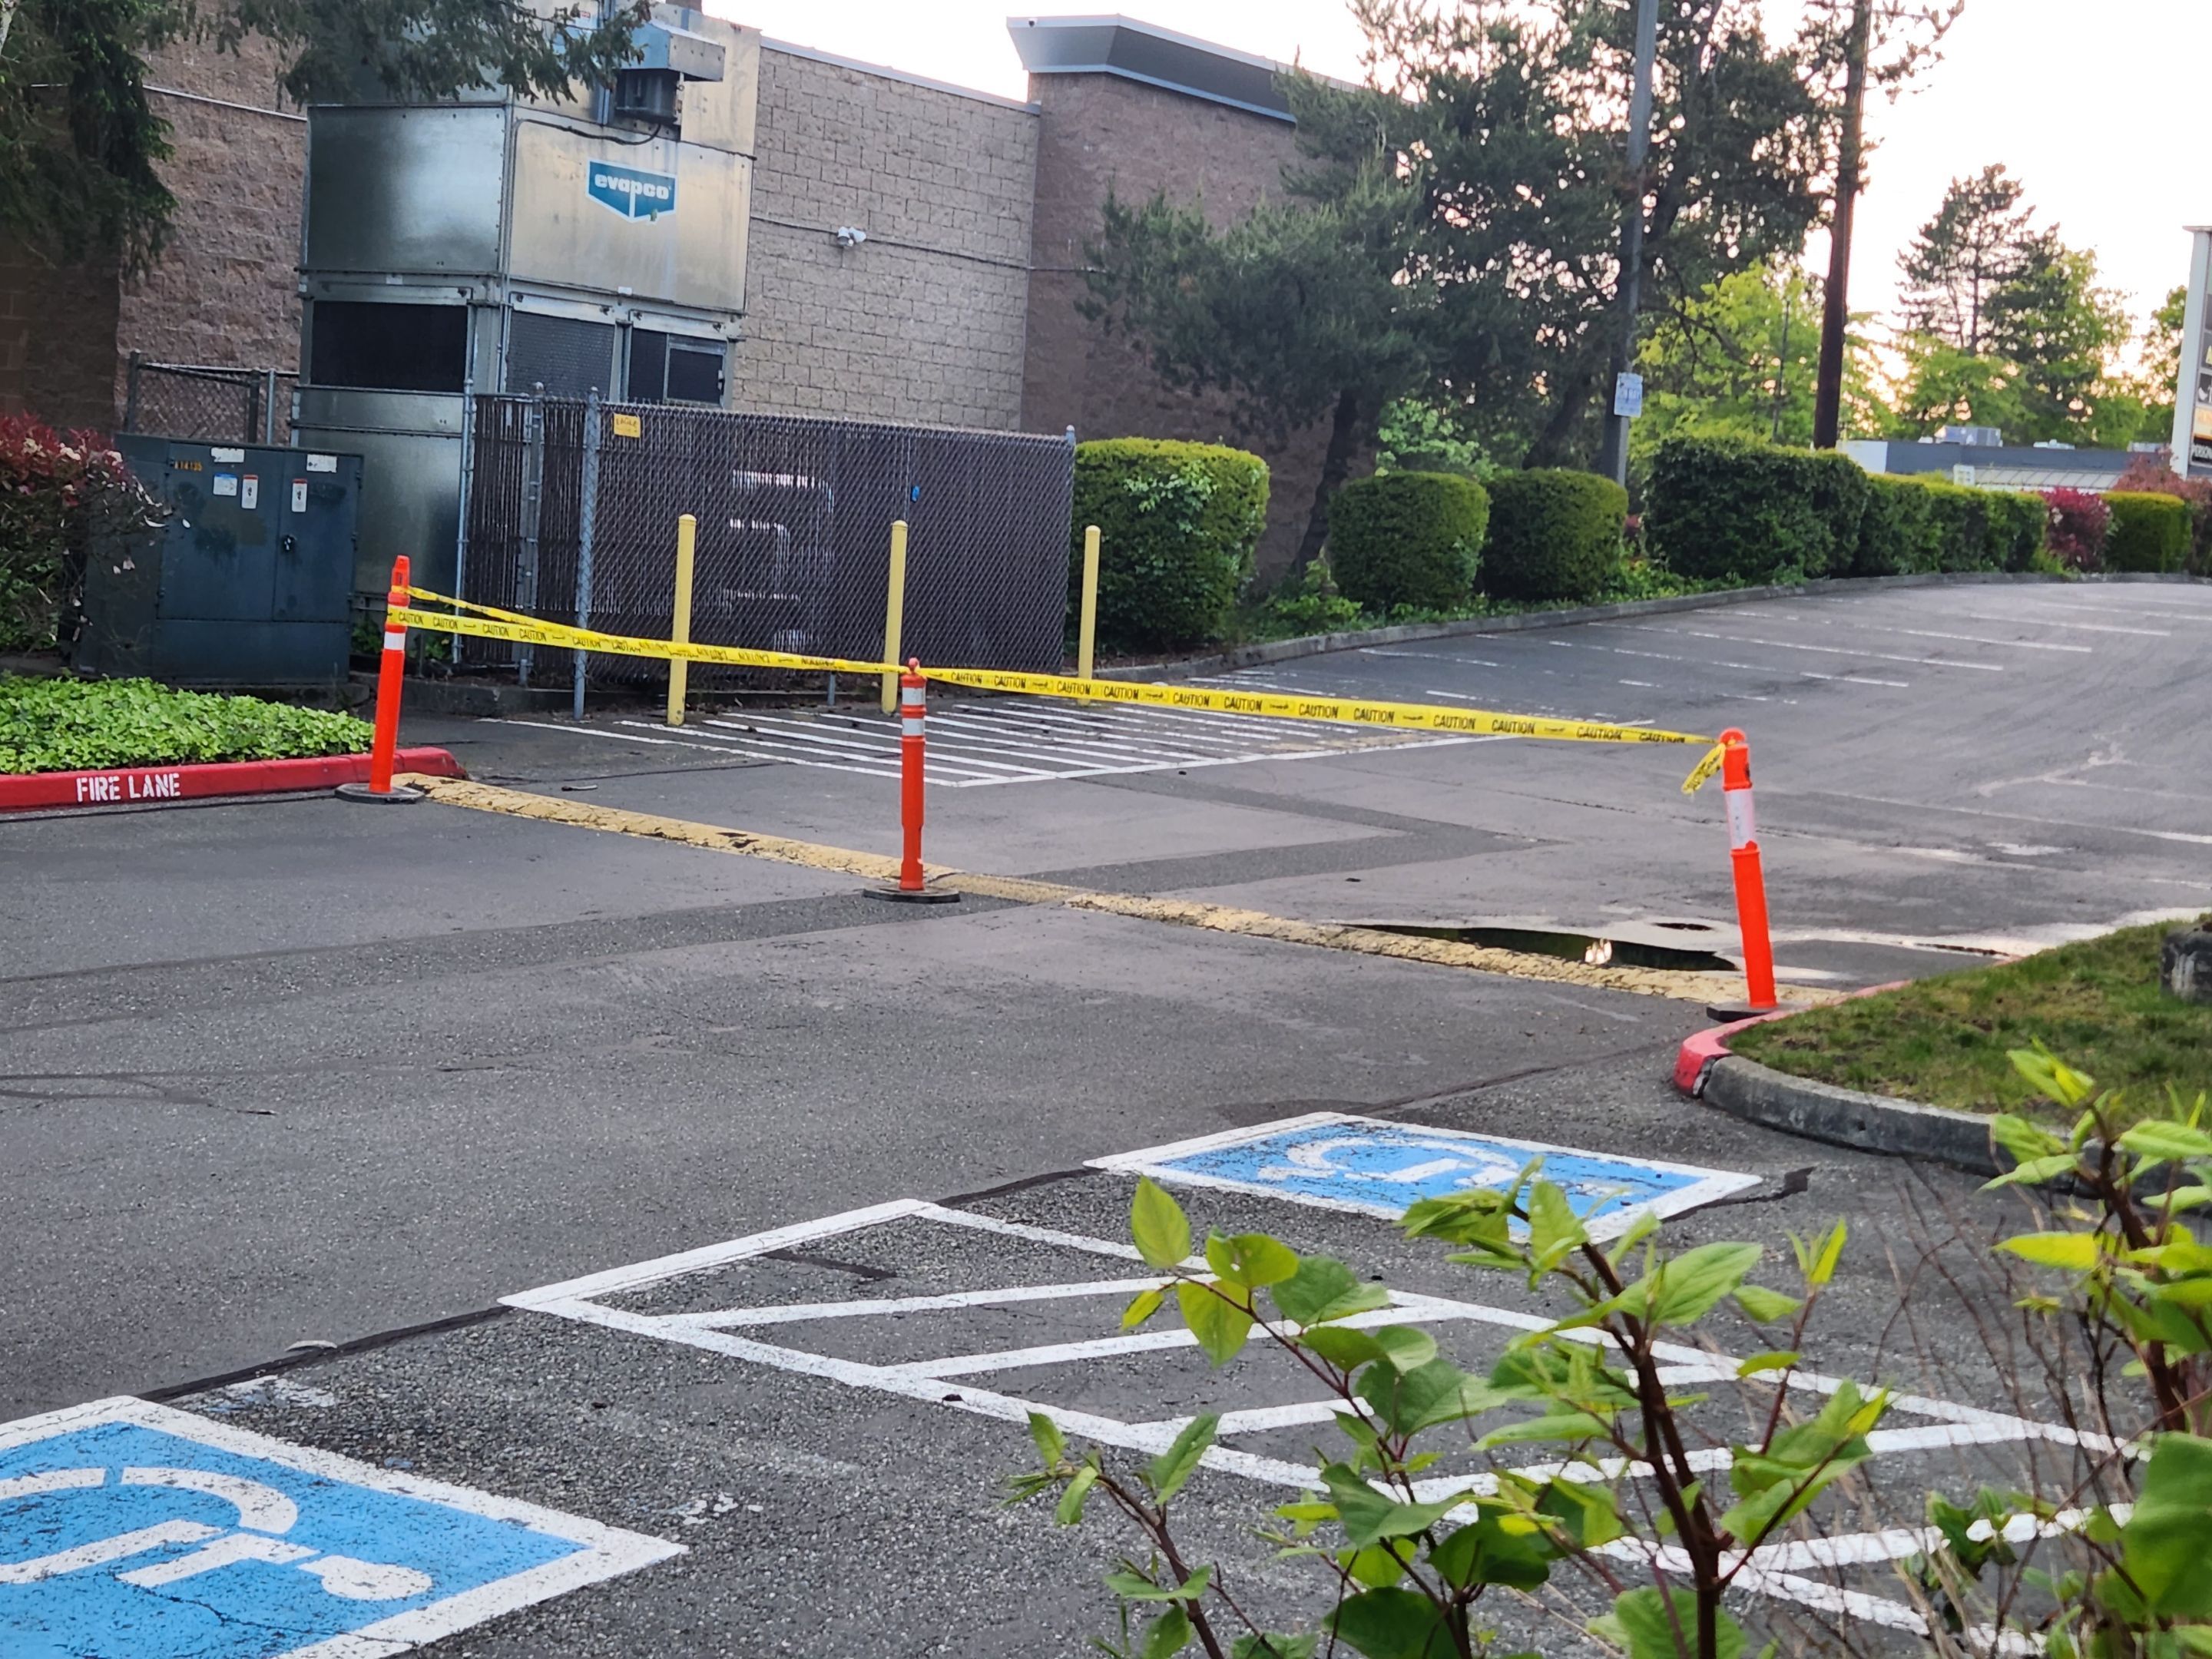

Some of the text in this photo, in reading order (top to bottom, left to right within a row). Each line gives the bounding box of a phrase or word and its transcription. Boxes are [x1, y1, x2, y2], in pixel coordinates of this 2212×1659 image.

[594, 174, 670, 210] evapco
[398, 612, 424, 625] CAUTION
[432, 615, 459, 630] CAUTION
[482, 623, 509, 637] CAUTION
[519, 628, 547, 642] CAUTION
[951, 671, 982, 684] CAUTION
[994, 676, 1026, 689] CAUTION
[1057, 681, 1091, 695] CAUTION
[1104, 686, 1138, 700] CAUTION
[1173, 691, 1210, 707] CAUTION
[1224, 696, 1262, 711] CAUTION
[1299, 703, 1339, 719] CAUTION
[1353, 707, 1395, 724] CAUTION
[1433, 714, 1476, 730] CAUTION
[1492, 719, 1535, 734] CAUTION
[1576, 726, 1622, 740] CAUTION
[77, 773, 181, 803] FIRE LANE
